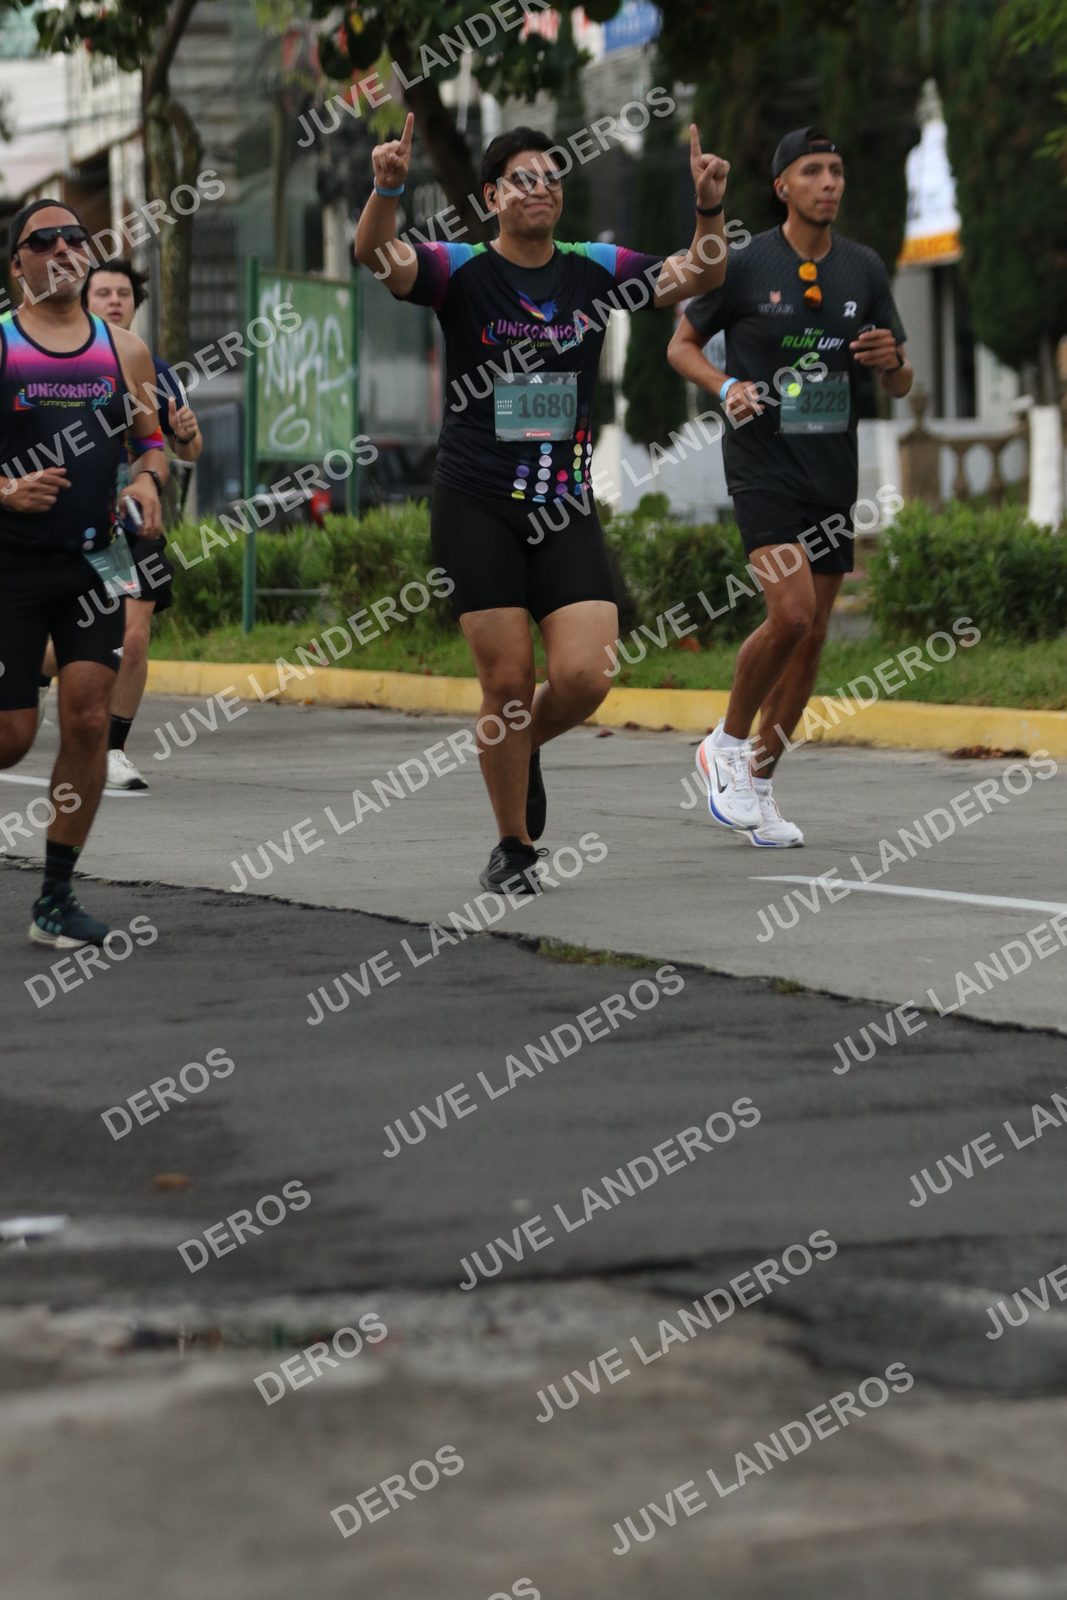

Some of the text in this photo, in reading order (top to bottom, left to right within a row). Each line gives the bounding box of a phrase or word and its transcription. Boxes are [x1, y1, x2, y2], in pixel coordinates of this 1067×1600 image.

[781, 336, 844, 350] RUN UP!
[518, 393, 575, 418] 1680
[800, 391, 847, 414] 3228
